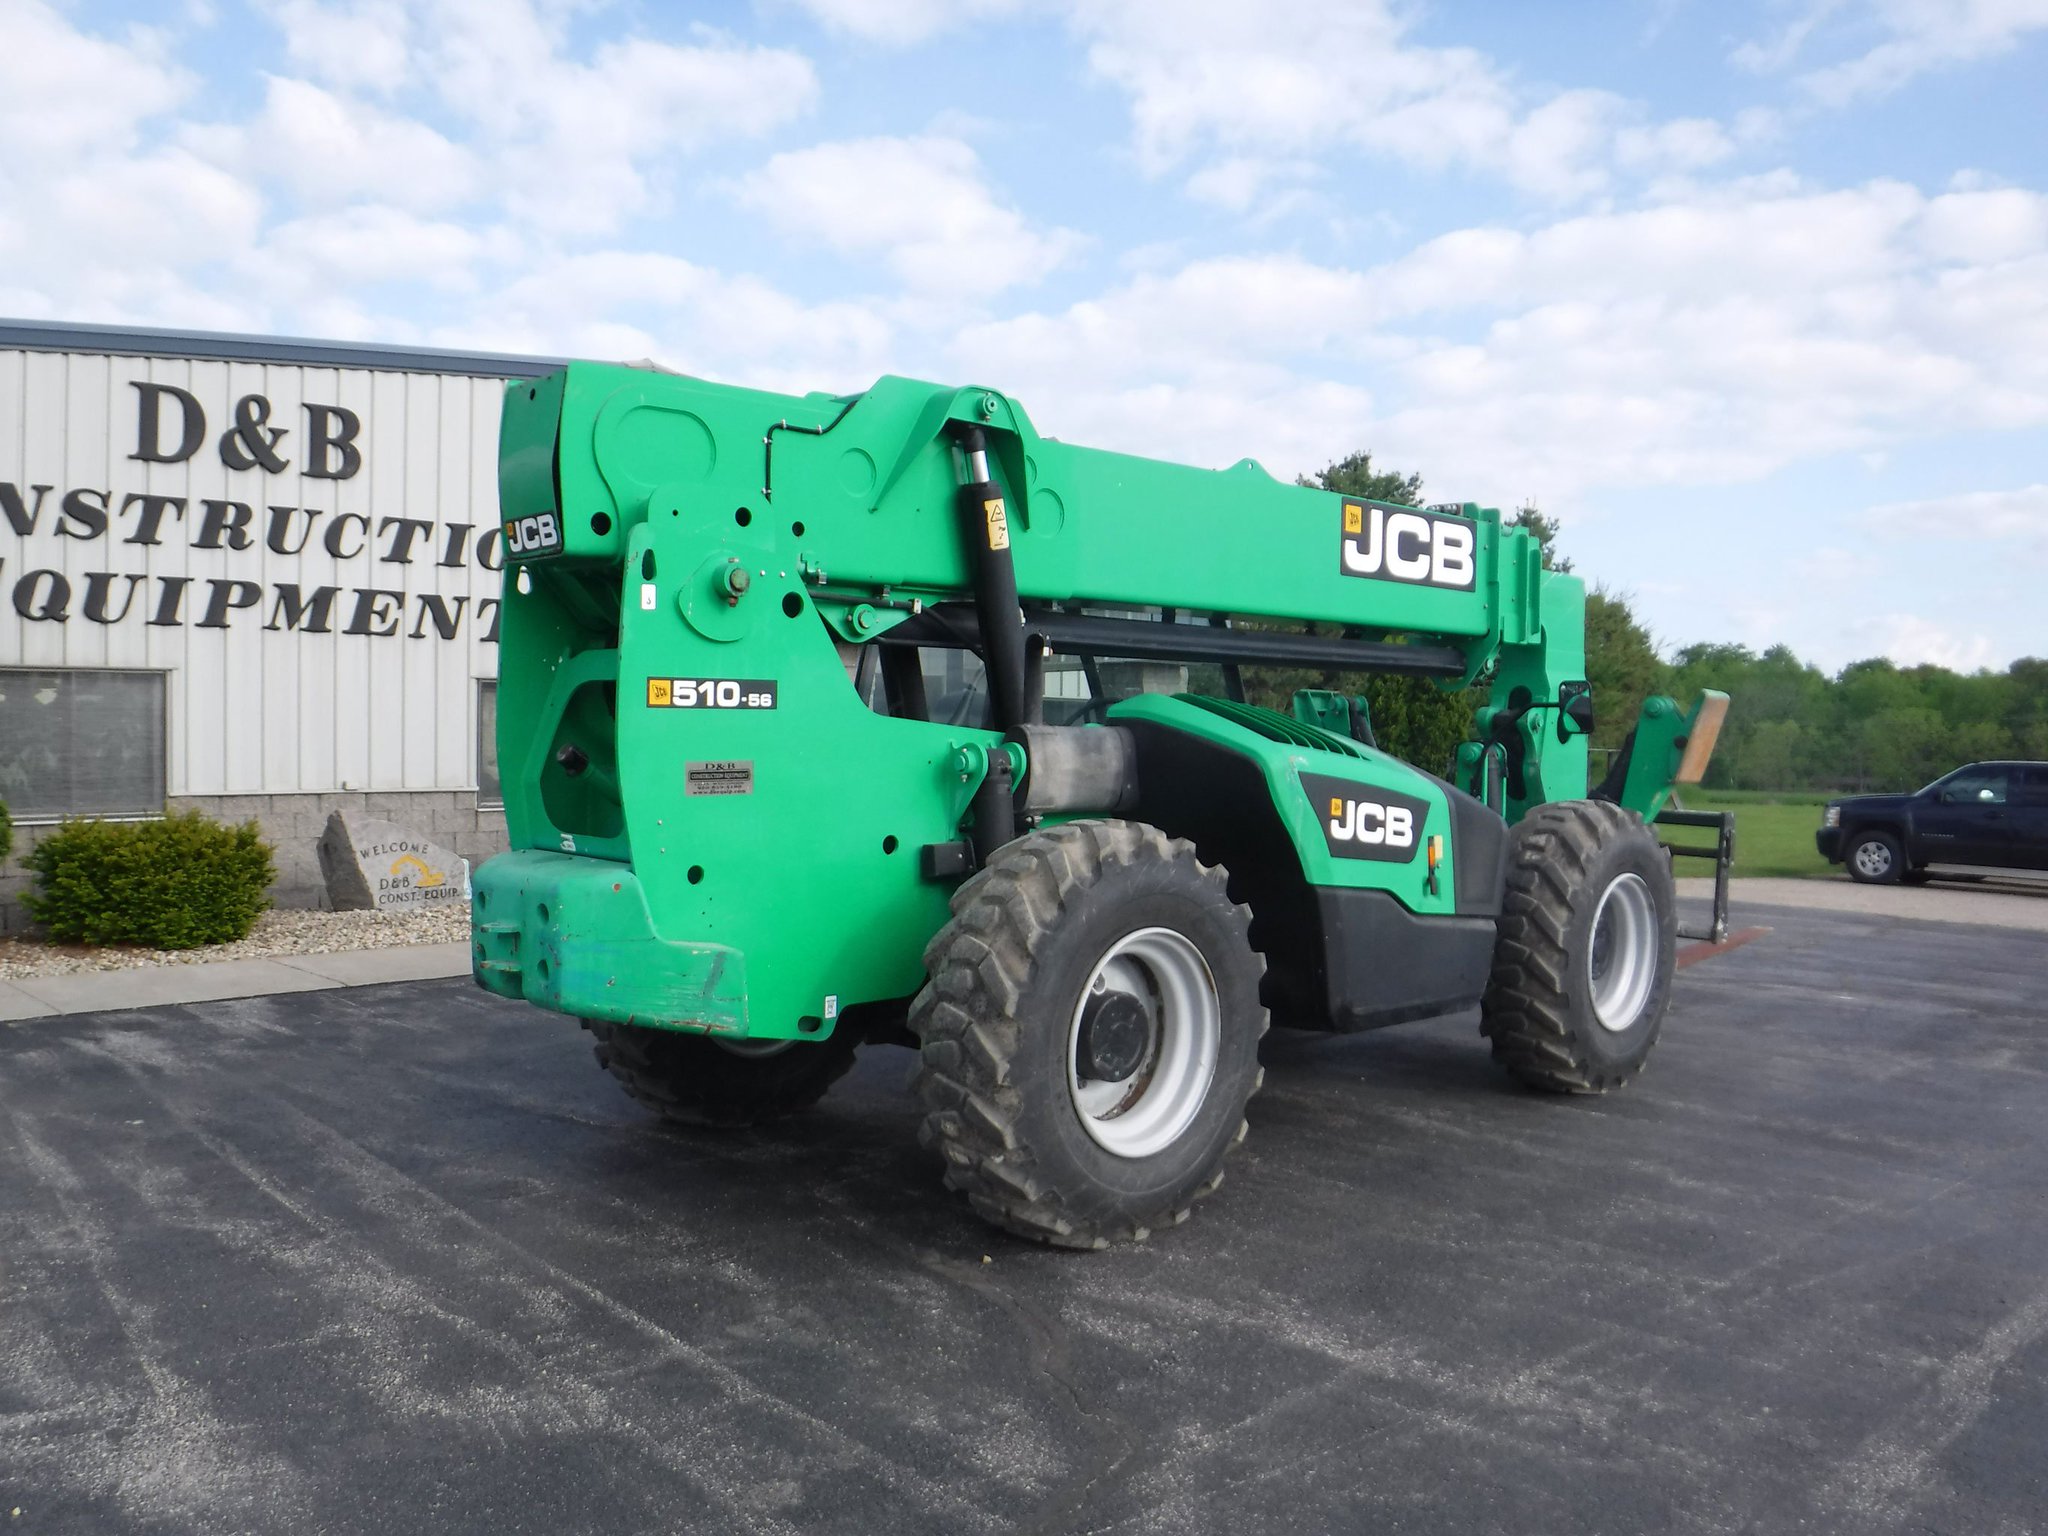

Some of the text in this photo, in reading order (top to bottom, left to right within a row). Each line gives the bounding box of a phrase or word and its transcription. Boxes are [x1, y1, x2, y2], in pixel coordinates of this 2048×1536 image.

[127, 380, 362, 480] D&B
[508, 513, 558, 553] JCB
[1344, 508, 1474, 586] JCB
[0, 557, 499, 642] QUIPMEN
[672, 680, 772, 707] 510-56
[1330, 799, 1413, 848] JCB
[360, 841, 429, 859] WELCOME
[379, 891, 420, 905] CONST.
[380, 876, 410, 890] D&B
